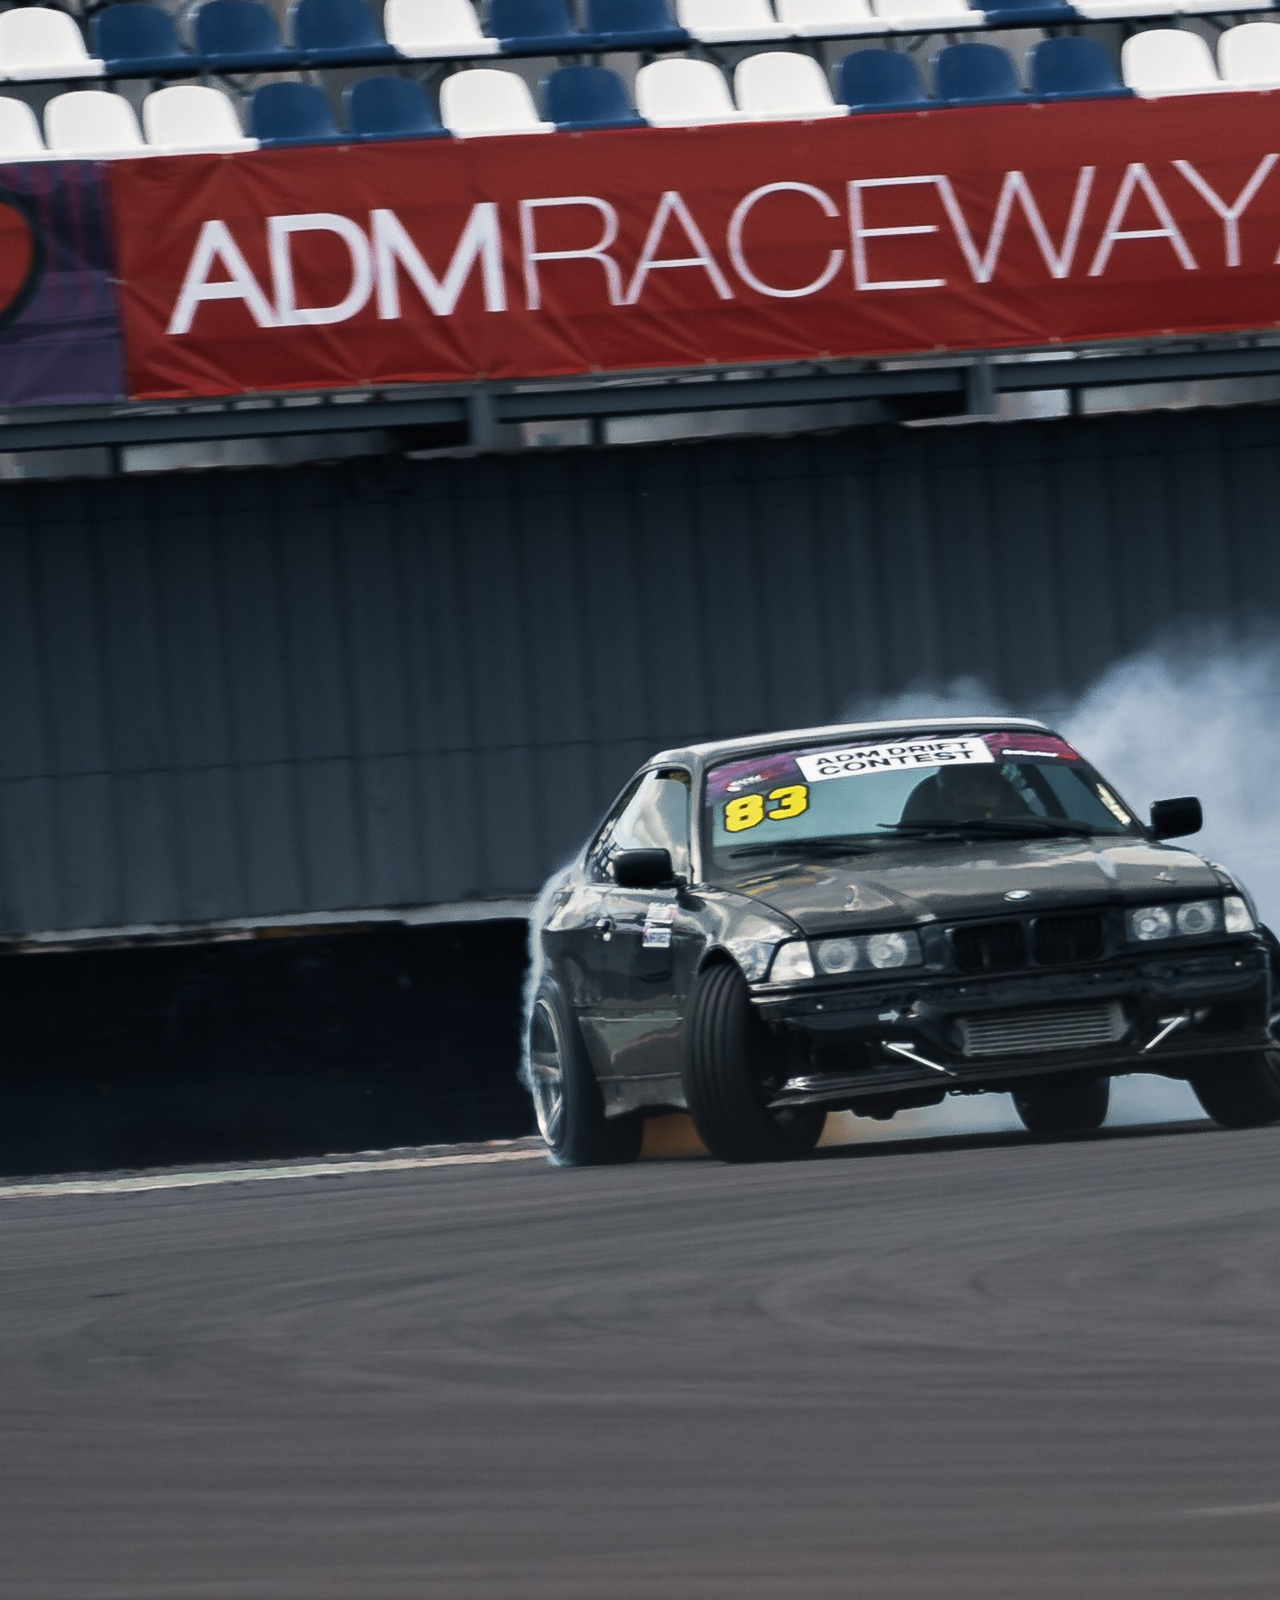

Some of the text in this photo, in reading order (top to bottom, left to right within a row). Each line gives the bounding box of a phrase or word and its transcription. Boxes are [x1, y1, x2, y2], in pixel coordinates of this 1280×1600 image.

[816, 742, 969, 765] ADM DRIFT
[819, 750, 973, 775] CONTEST
[725, 785, 808, 832] 83
